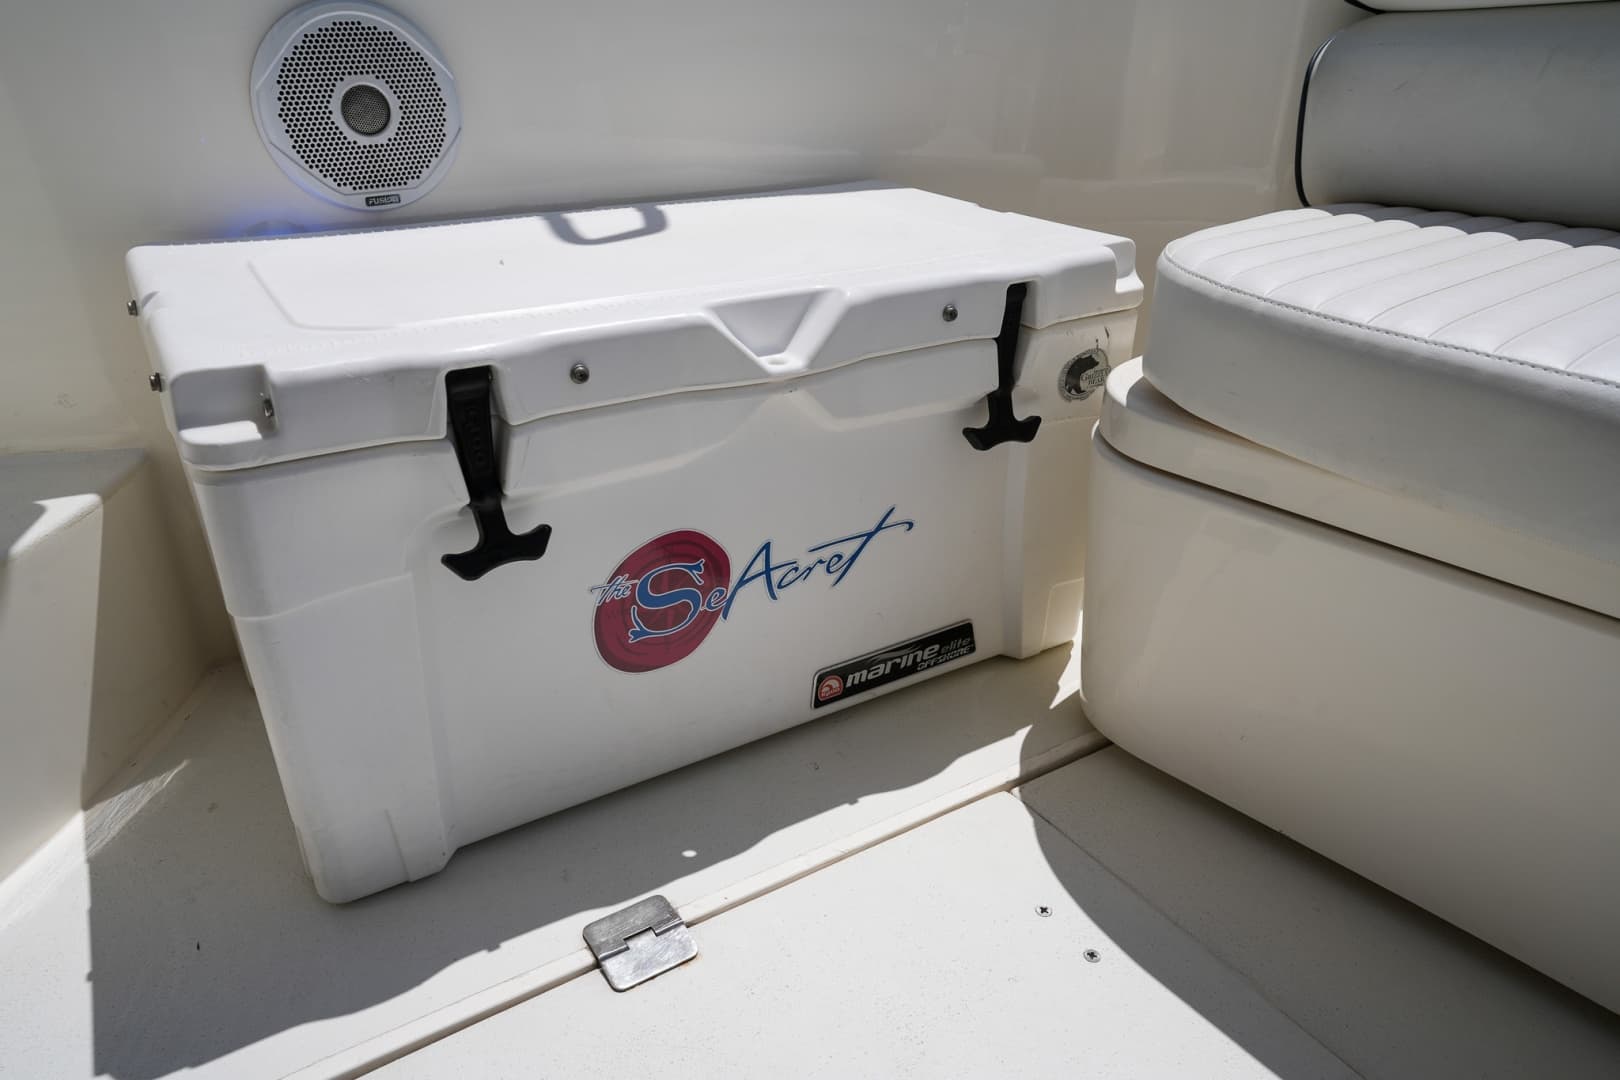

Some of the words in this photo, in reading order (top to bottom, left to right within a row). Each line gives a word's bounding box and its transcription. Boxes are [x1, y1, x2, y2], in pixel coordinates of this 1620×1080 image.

[589, 574, 639, 605] the
[846, 643, 941, 688] marine
[941, 637, 971, 654] elite
